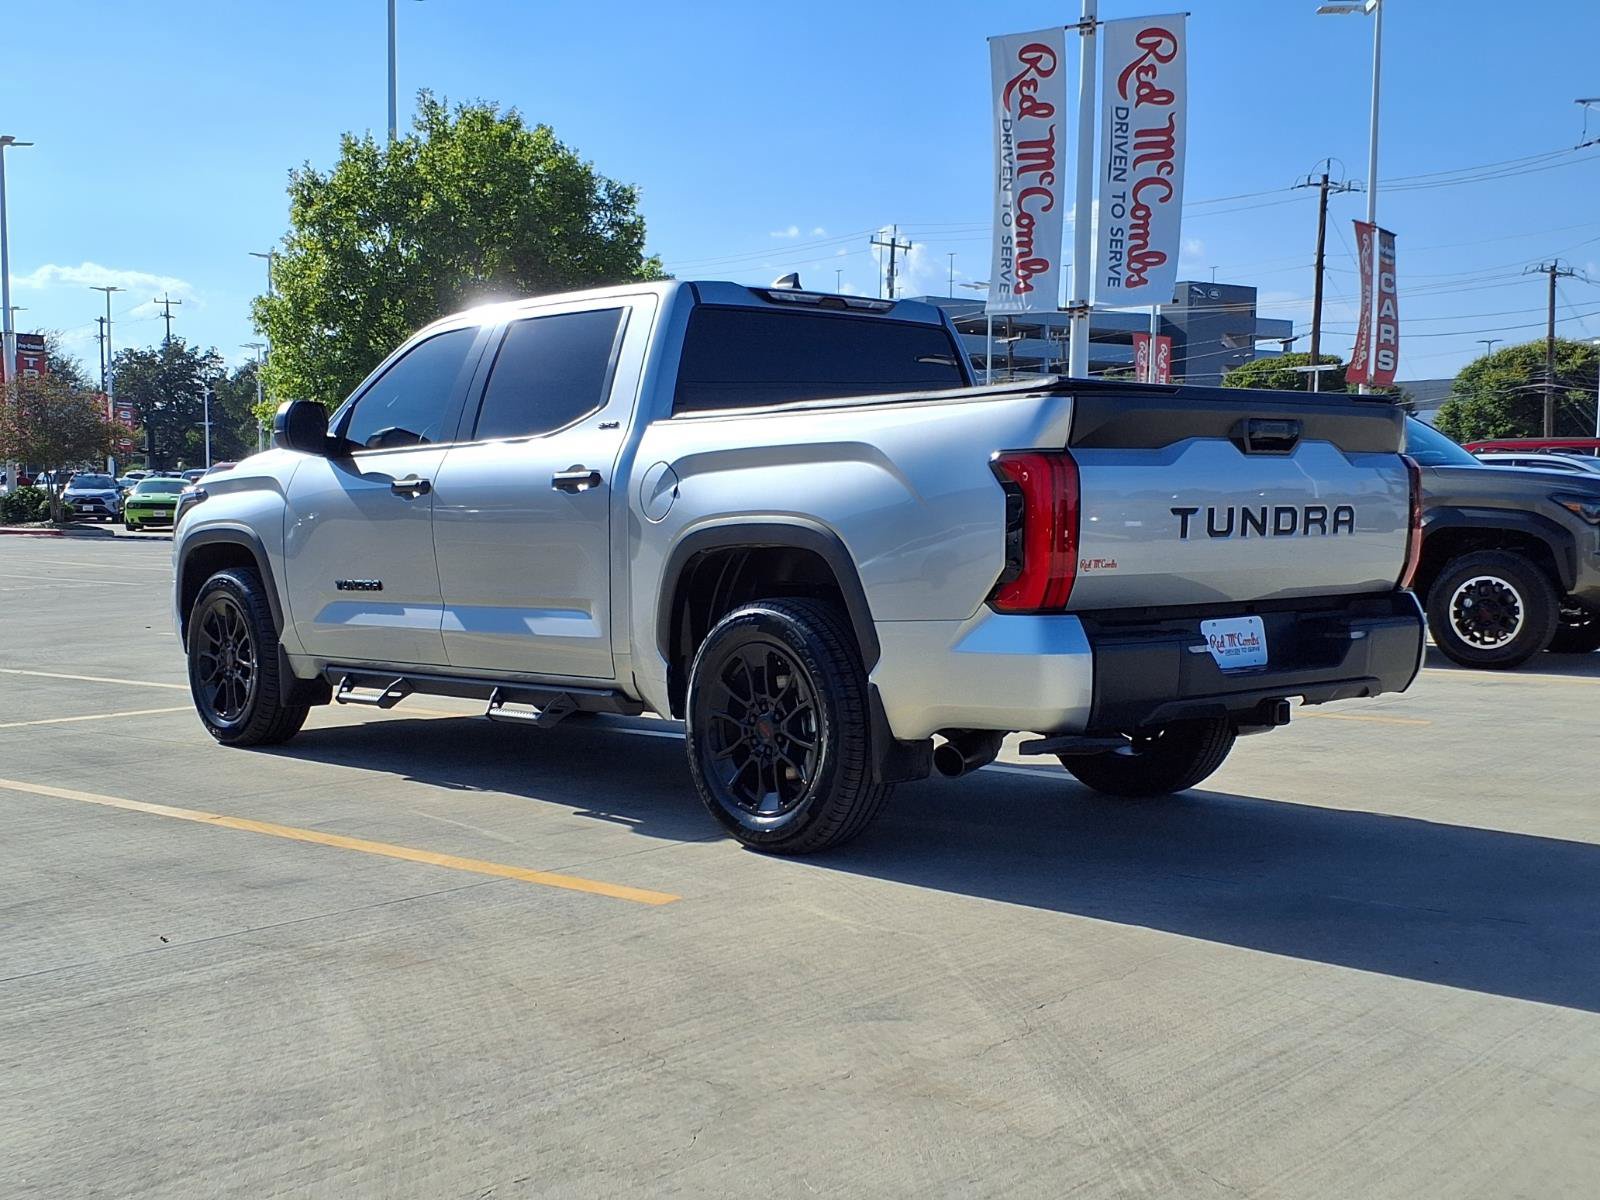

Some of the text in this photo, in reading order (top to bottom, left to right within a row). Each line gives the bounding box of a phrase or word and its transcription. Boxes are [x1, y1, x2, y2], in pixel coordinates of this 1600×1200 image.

[1003, 43, 1057, 121] Red
[1117, 27, 1178, 109] Red
[998, 119, 1013, 294] DRIVEN TO SERVE
[1107, 106, 1129, 288] DRIVEN TO SERVE
[1377, 271, 1396, 372] CARS
[1169, 504, 1356, 539] TUNDRA
[1080, 558, 1092, 573] Red
[1209, 633, 1225, 654] Red
